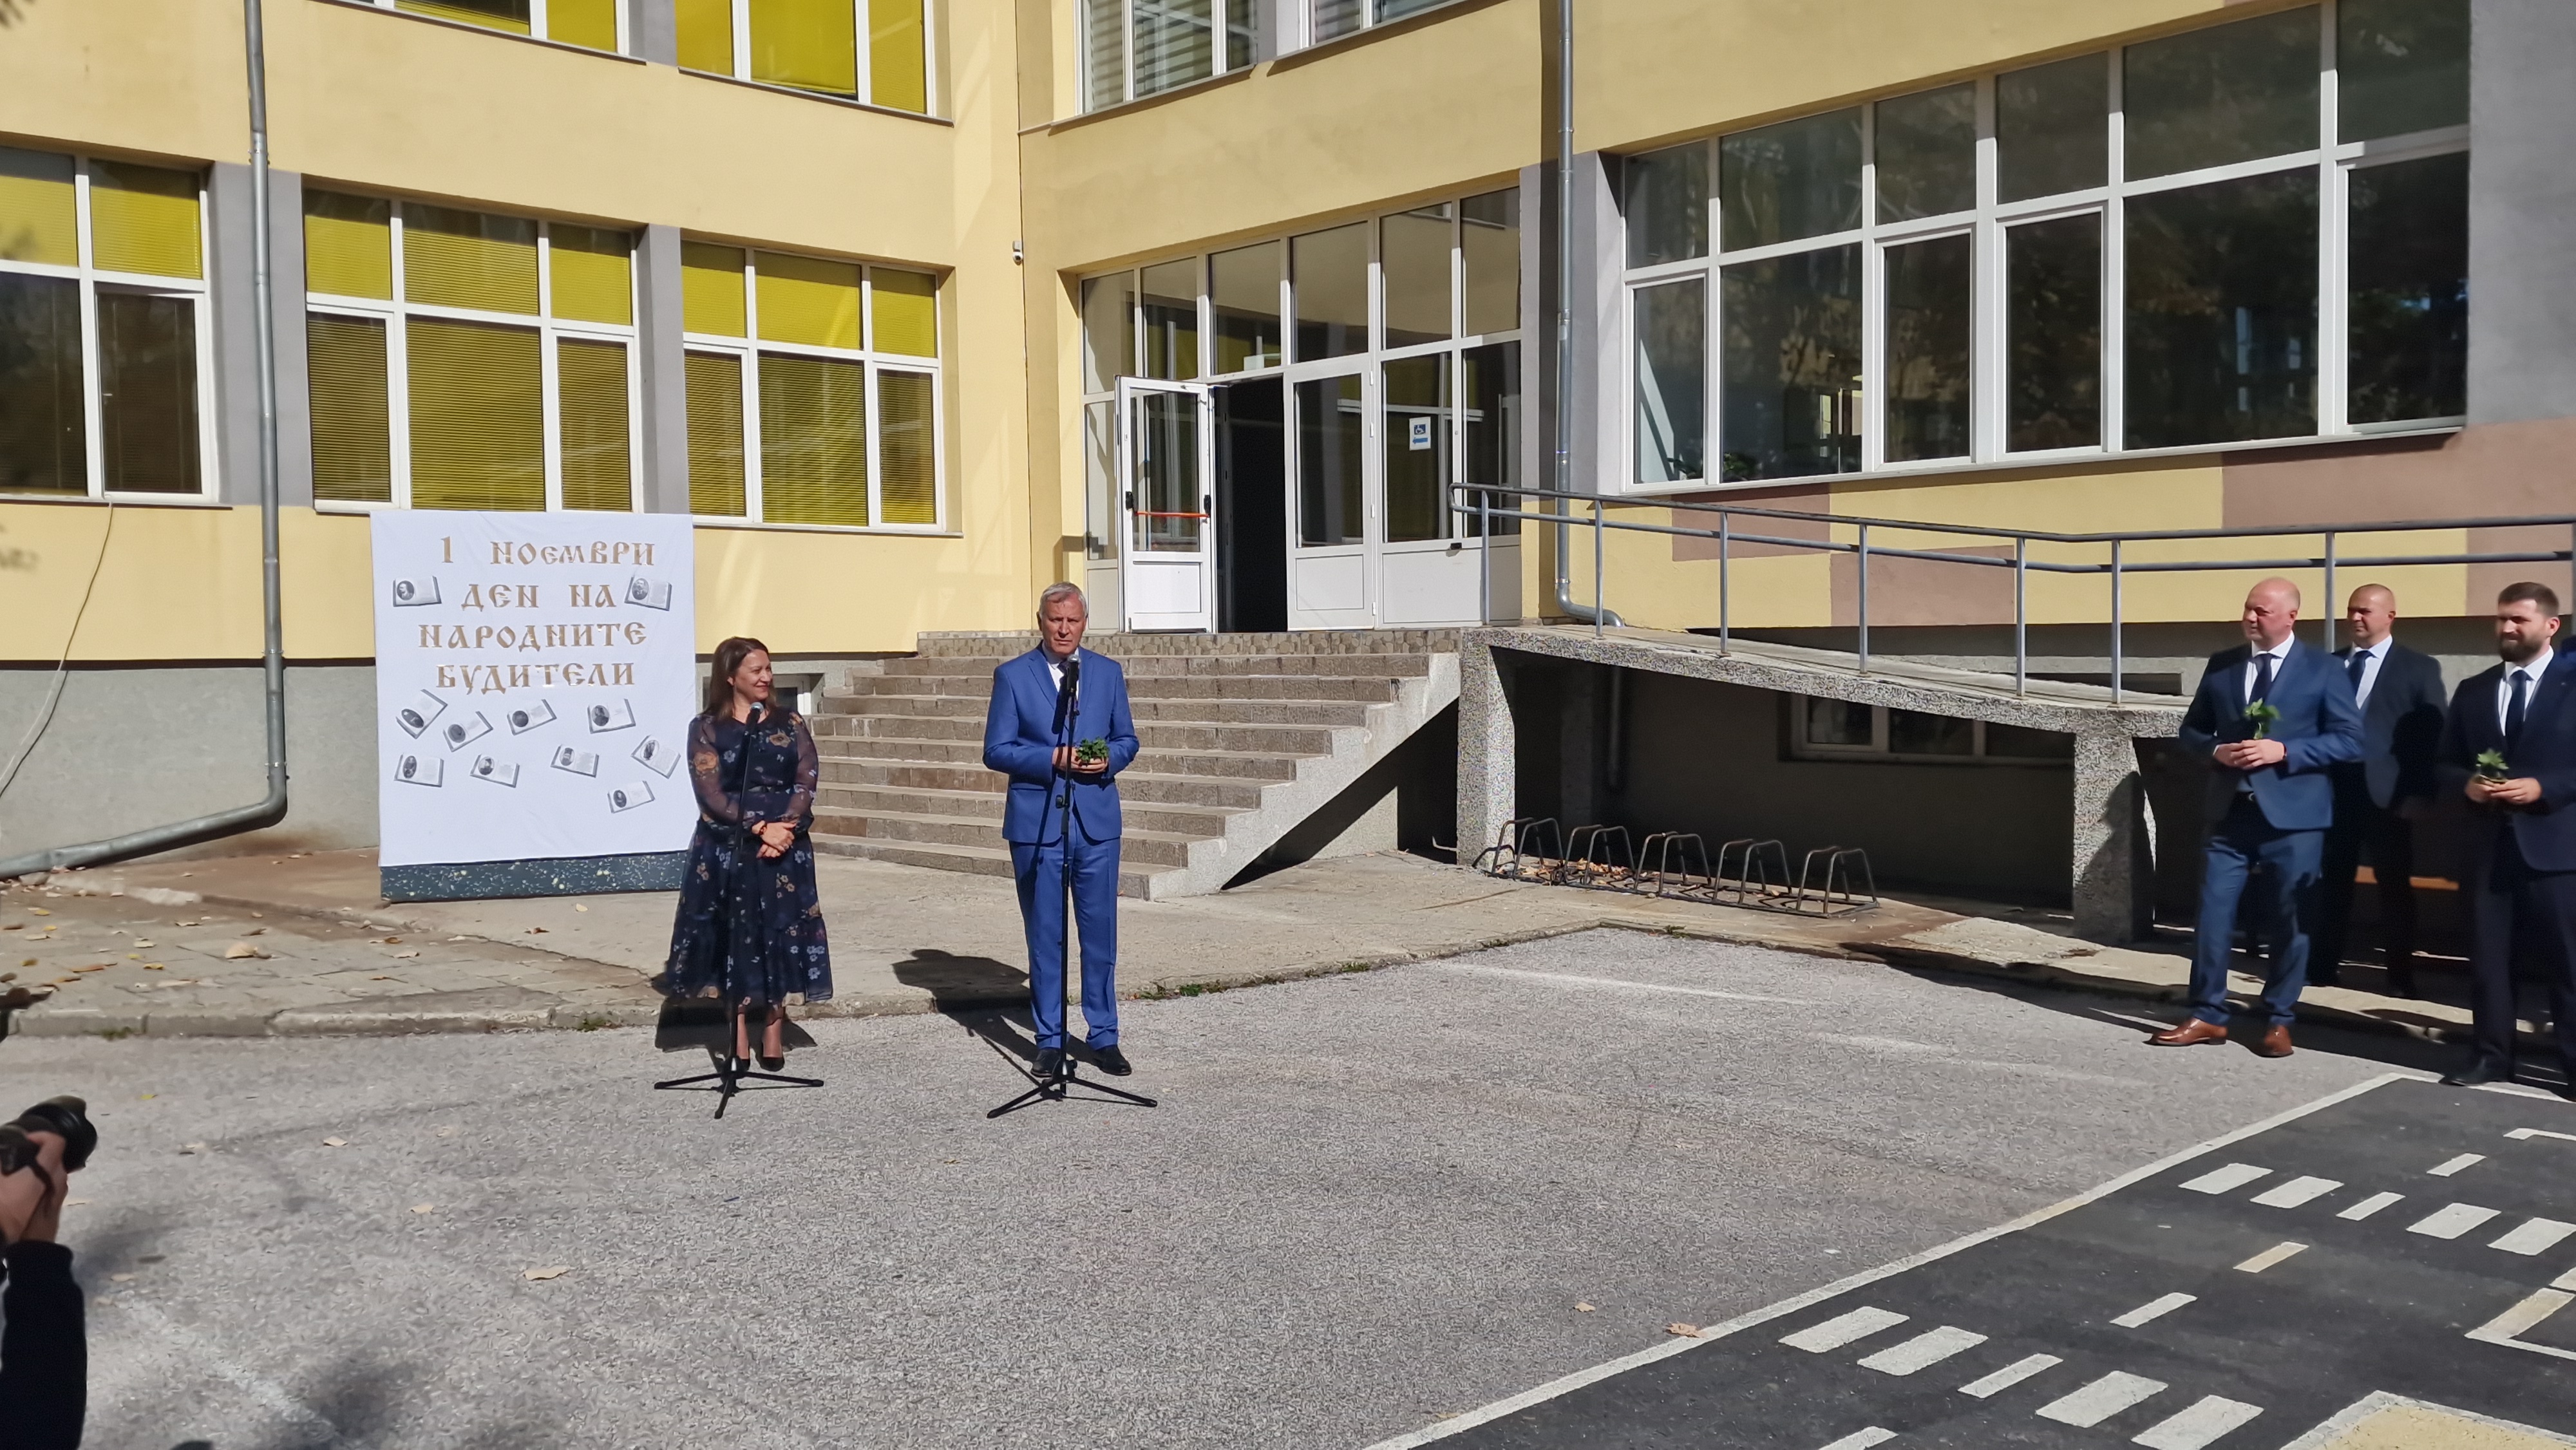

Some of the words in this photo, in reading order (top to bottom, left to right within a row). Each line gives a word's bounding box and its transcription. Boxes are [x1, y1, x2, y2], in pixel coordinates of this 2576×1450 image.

[440, 536, 454, 563] 1
[460, 583, 540, 612] ДЕН
[568, 583, 618, 608] НА
[418, 621, 647, 652] НАРОДНИТЕ
[435, 662, 635, 695] БУДИТЕЛИ
